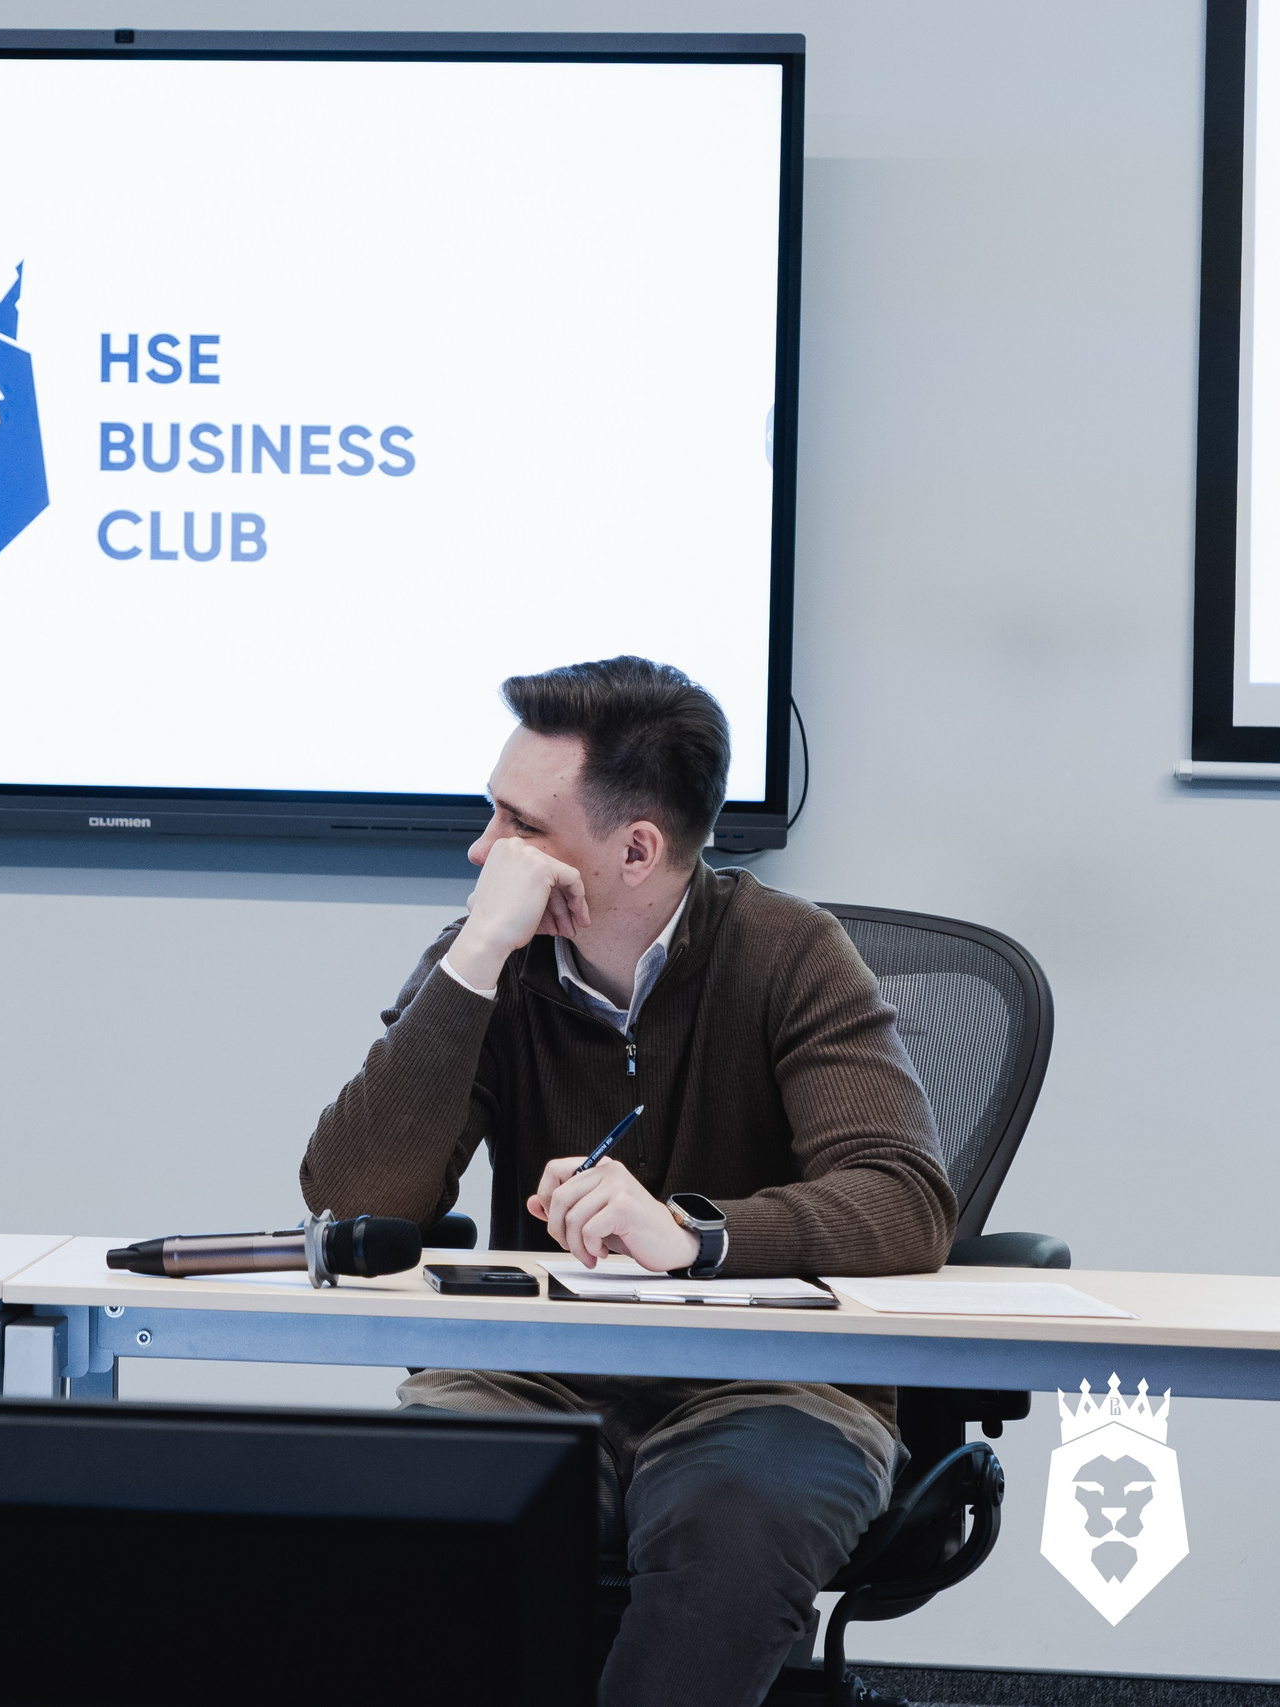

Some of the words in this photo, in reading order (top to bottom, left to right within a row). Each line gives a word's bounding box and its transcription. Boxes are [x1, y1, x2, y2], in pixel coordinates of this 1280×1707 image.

[100, 333, 221, 384] HSE
[99, 421, 416, 477] BUSINESS
[97, 509, 268, 562] CLUB
